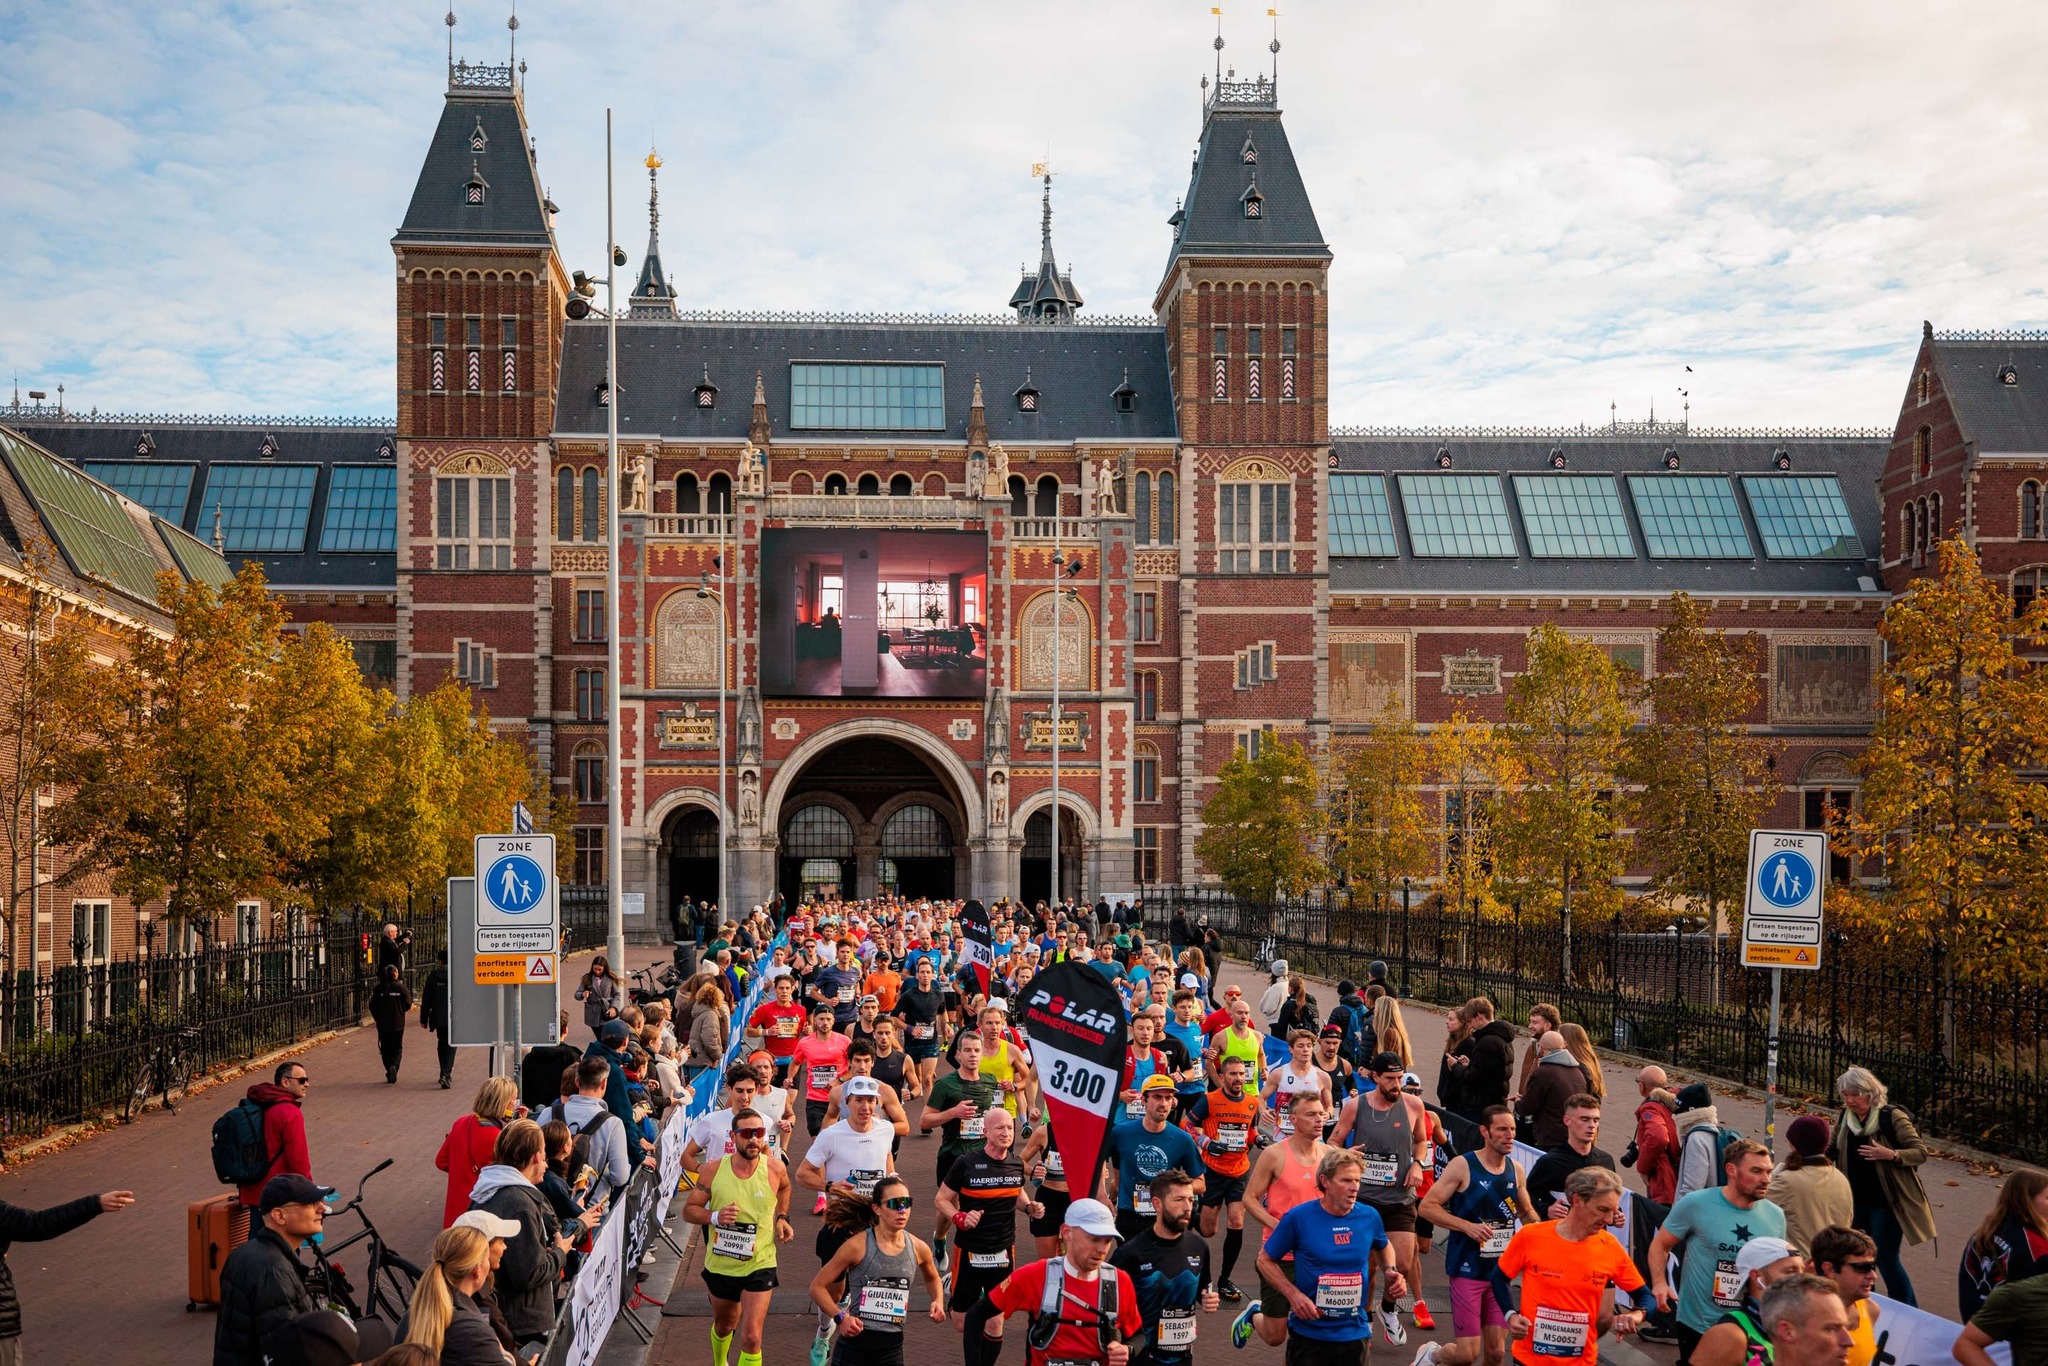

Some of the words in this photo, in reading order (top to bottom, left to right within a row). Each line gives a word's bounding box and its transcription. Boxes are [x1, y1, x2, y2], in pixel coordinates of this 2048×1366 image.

[498, 843, 532, 852] ZONE
[1774, 838, 1804, 848] ZONE
[1777, 924, 1815, 932] toegestaan
[508, 932, 550, 940] toegestaan
[512, 941, 540, 949] rijloper
[1749, 946, 1791, 954] snorfietsers
[477, 959, 527, 967] snorfietsers
[477, 970, 515, 978] verboden
[1029, 989, 1117, 1034] POLAR
[1050, 1059, 1106, 1104] 3:00
[1366, 1162, 1394, 1171] CAMERON
[969, 1176, 1004, 1184] HAERENS
[719, 1232, 751, 1243] KLEANTHIS
[723, 1241, 744, 1250] 20998
[1718, 1261, 1733, 1272] tcs
[1721, 1277, 1735, 1285] OLE
[867, 1290, 903, 1301] GIULIANA
[875, 1301, 894, 1310] 4453
[1325, 1298, 1355, 1306] M60030
[860, 1312, 892, 1322] AMSTERDAM
[1162, 1308, 1175, 1318] tcs
[1537, 1310, 1573, 1322] AMSTERDAM
[1540, 1323, 1582, 1334] DINGEMANSE
[1172, 1332, 1189, 1340] 1597
[1543, 1333, 1577, 1344] M50052
[1534, 1344, 1547, 1354] tcs
